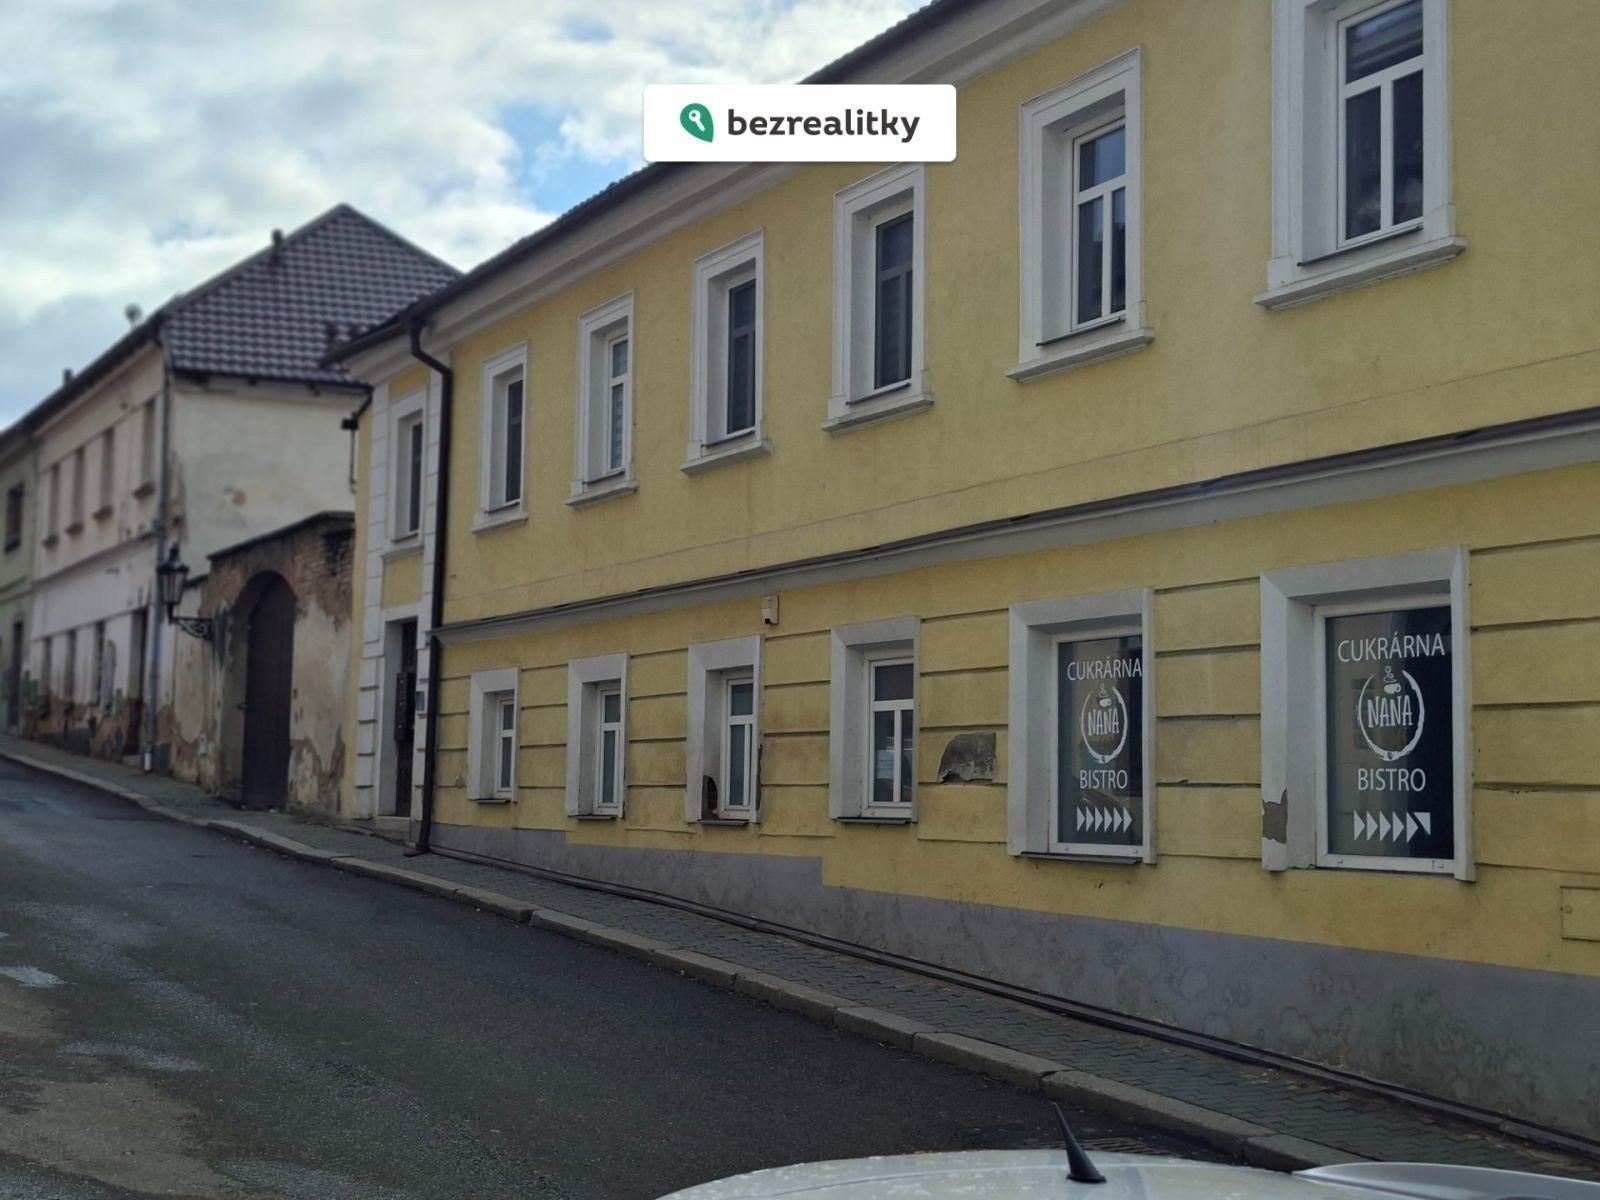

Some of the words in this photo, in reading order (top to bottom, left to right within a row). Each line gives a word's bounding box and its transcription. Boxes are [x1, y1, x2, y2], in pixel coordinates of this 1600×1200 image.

[1338, 631, 1445, 662] CUKRÁRNA
[1067, 656, 1142, 681] CUKRÁRNA
[1087, 707, 1119, 736] NANA
[1367, 694, 1413, 728] NANA
[1080, 769, 1128, 790] BISTRO
[1358, 768, 1426, 792] BISTRO
